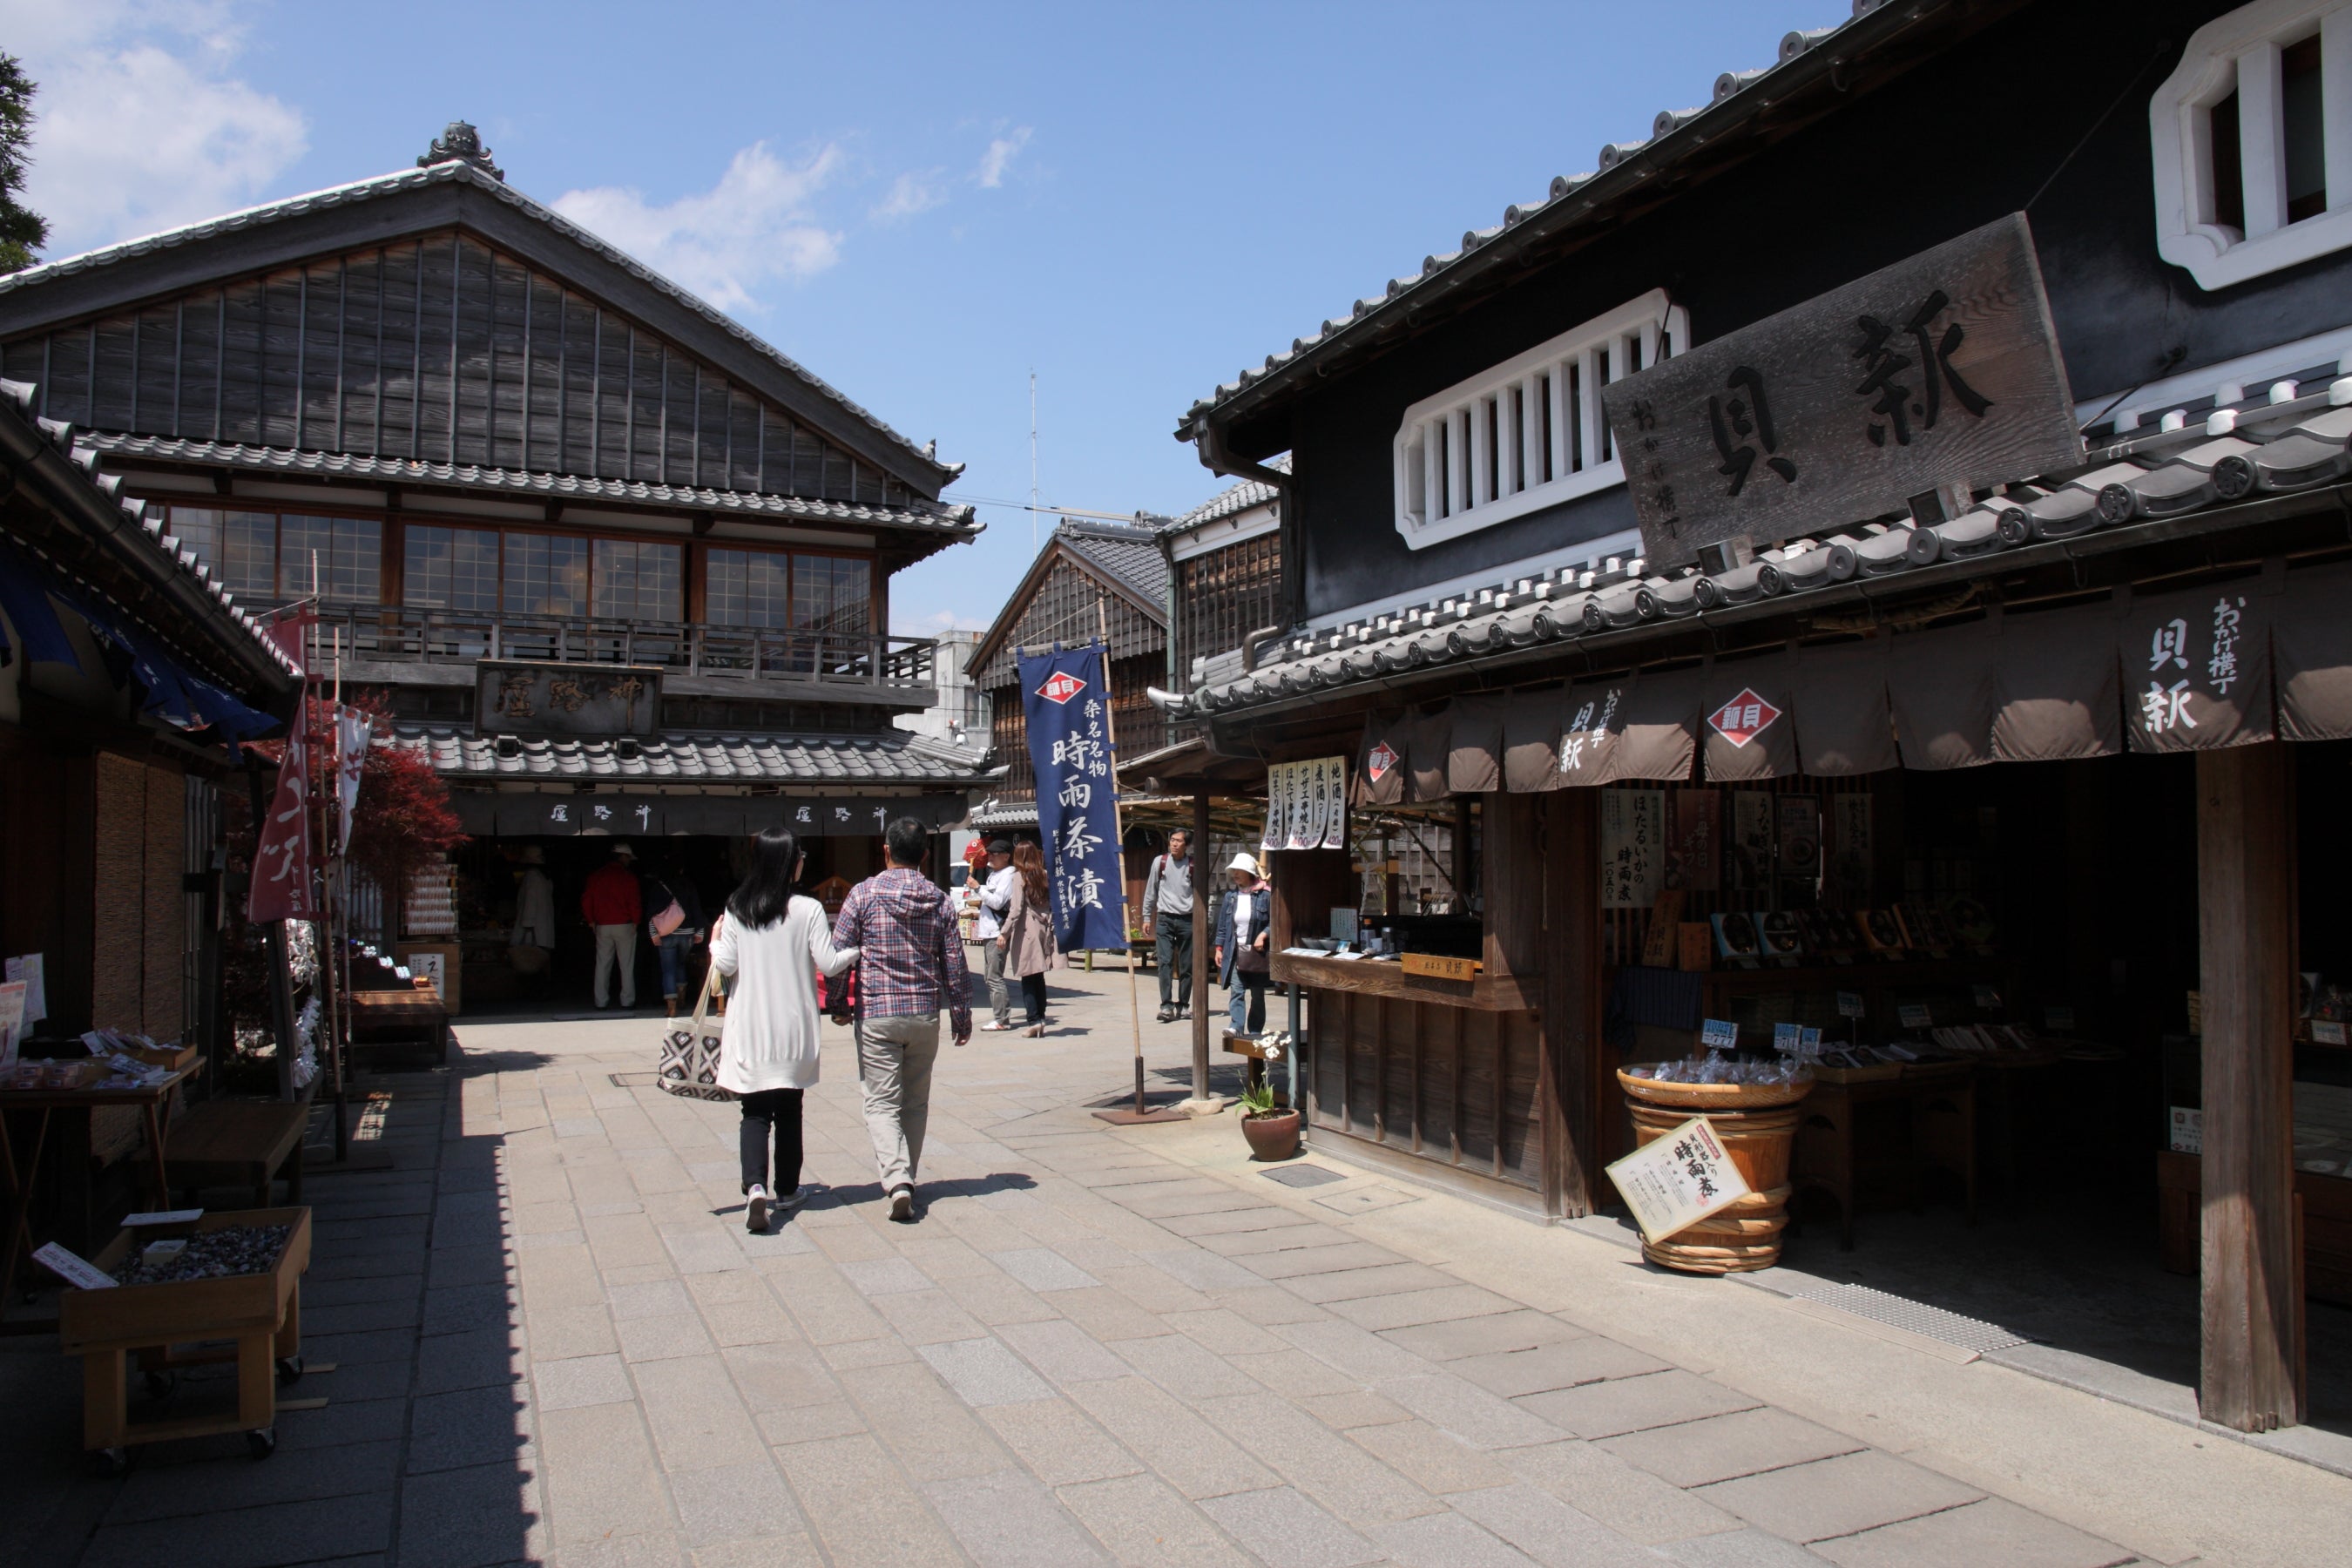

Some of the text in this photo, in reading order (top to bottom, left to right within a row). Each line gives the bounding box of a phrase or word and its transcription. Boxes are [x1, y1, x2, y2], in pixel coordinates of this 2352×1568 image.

[1708, 289, 1995, 497] 貝新
[2142, 618, 2198, 733] 貝新
[2208, 597, 2247, 694] おかげ横丁
[1084, 699, 1107, 778] 桑名名物
[1561, 701, 1594, 774] 貝新
[1051, 730, 1105, 910] 時雨茶漬
[1286, 767, 1294, 835] ほたて串焼
[1632, 796, 1648, 884] ほたるいかの
[1618, 846, 1632, 902] 時雨煮
[1693, 821, 1710, 868] 母の日
[1674, 1140, 1719, 1199] 時雨煮
